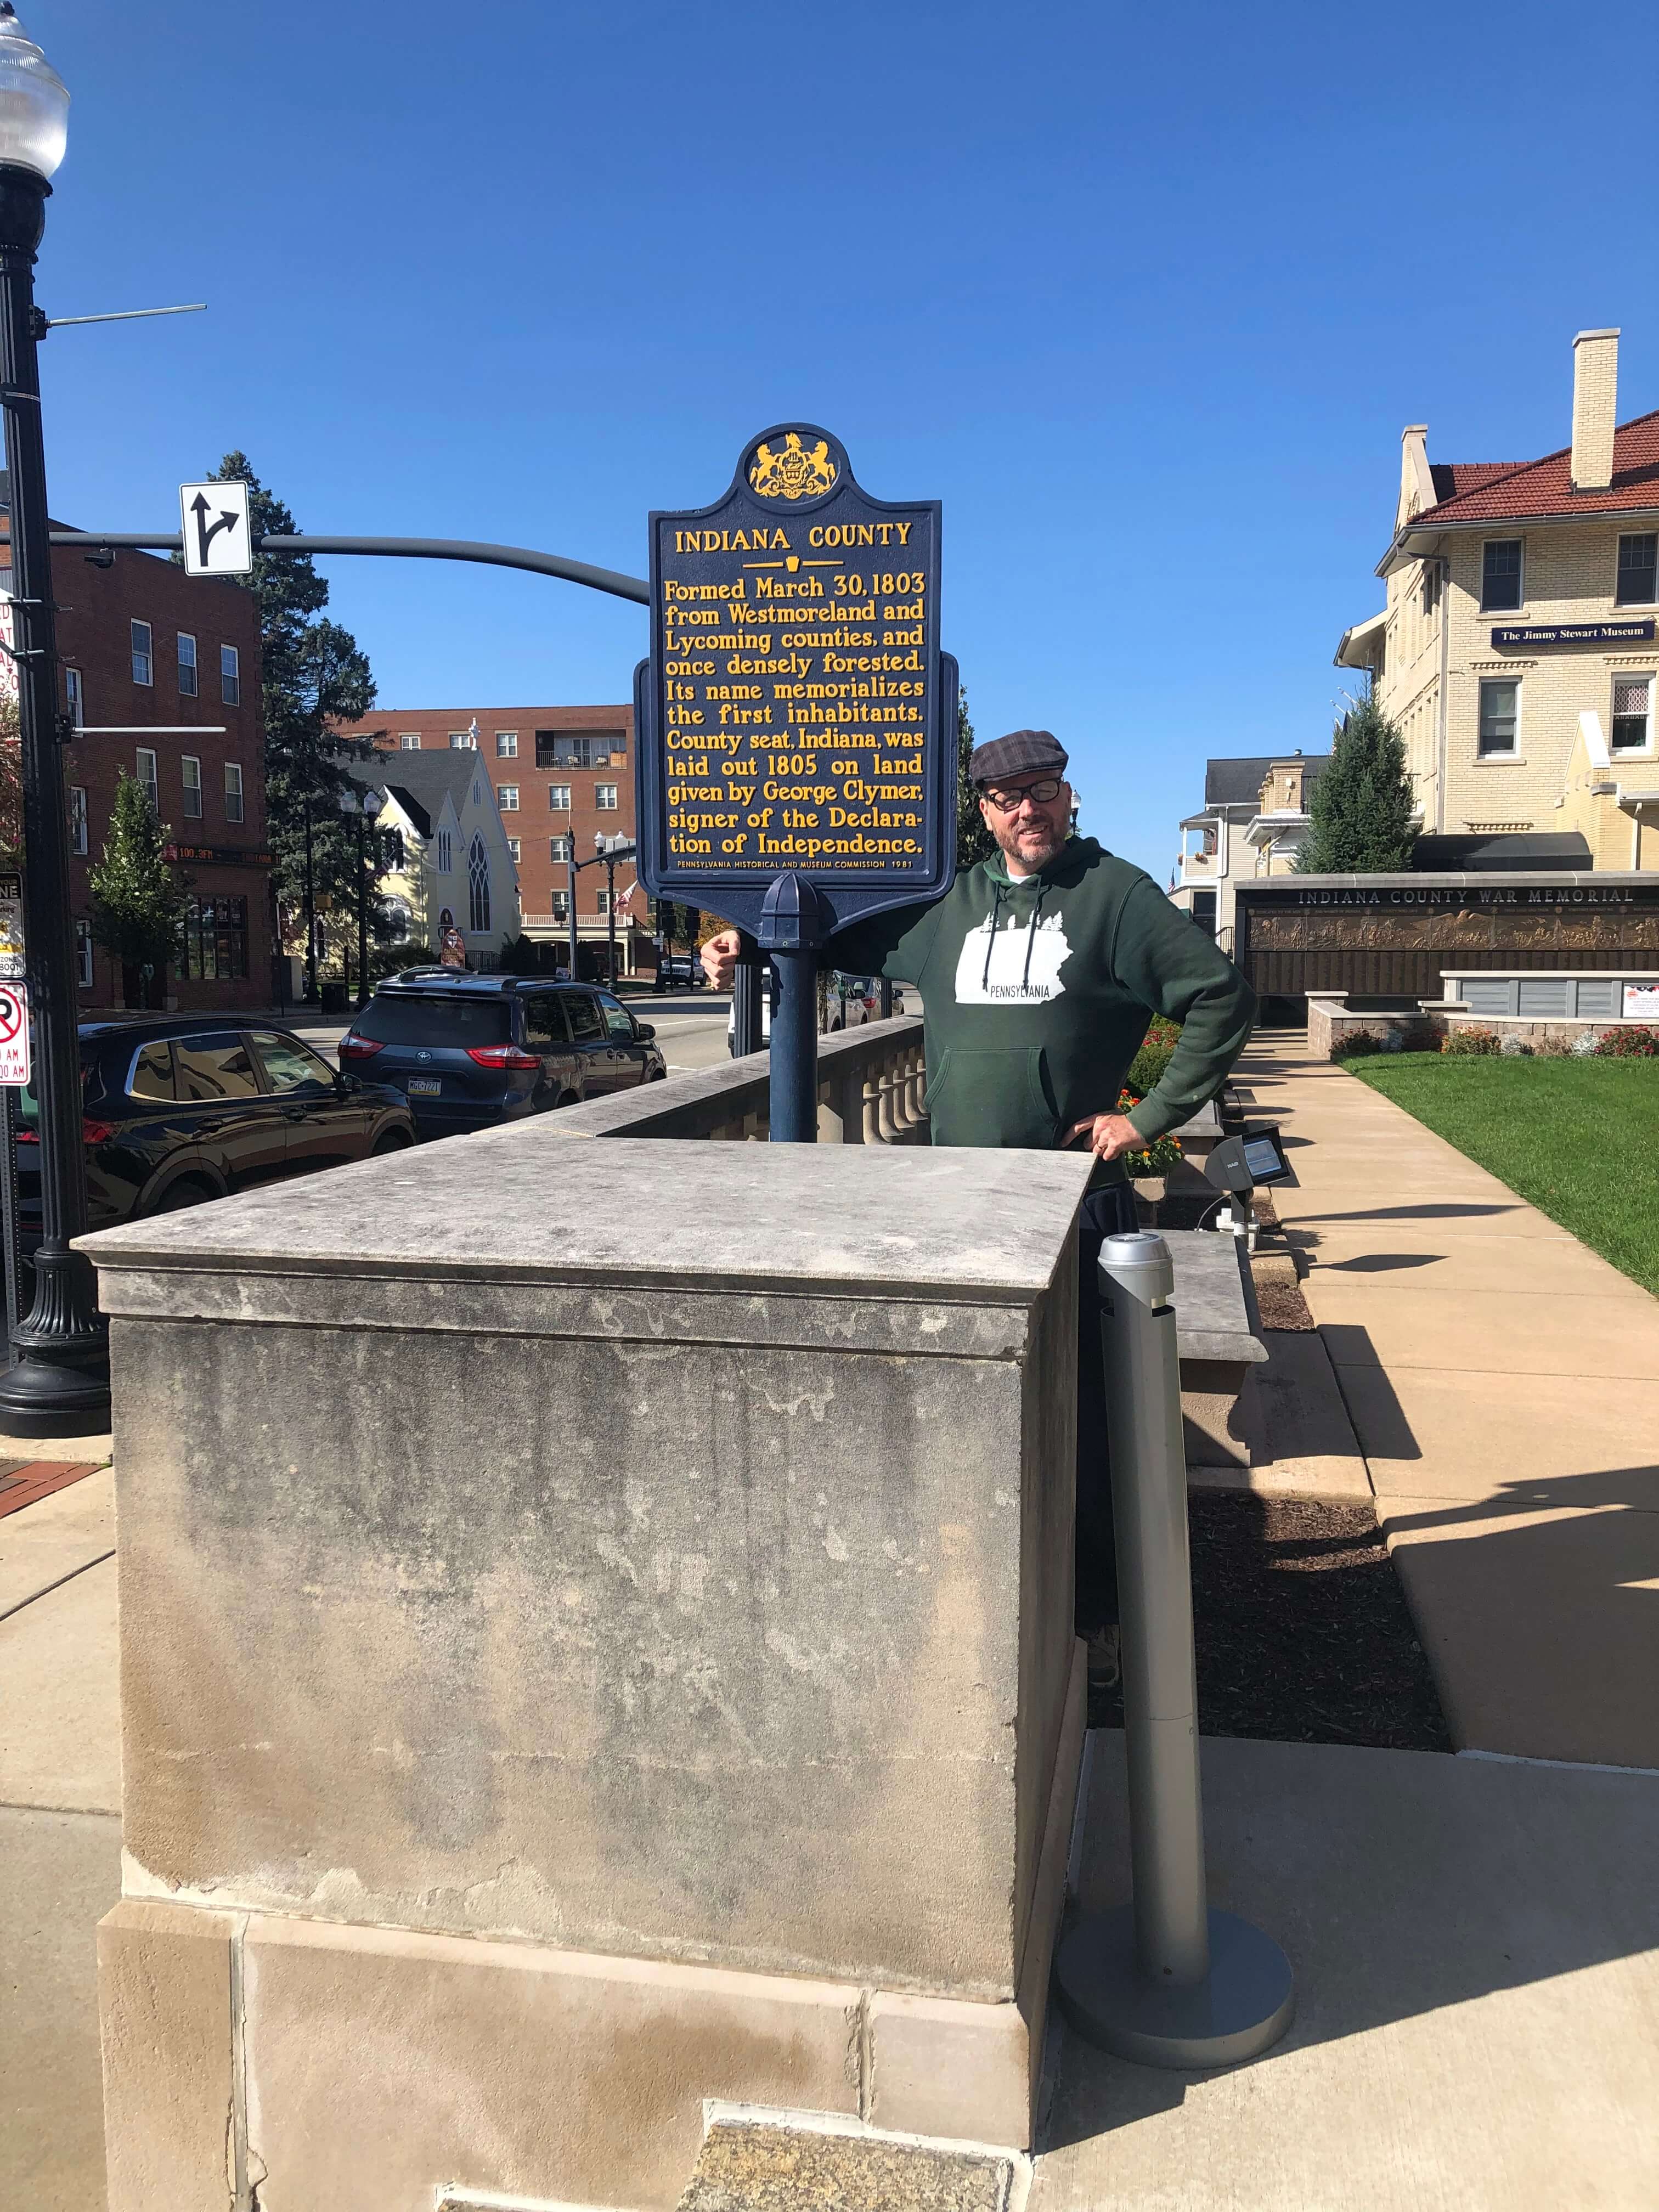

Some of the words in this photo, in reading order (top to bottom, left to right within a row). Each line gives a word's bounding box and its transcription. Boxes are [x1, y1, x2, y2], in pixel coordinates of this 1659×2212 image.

[676, 529, 789, 552] INDIANA
[809, 523, 910, 547] COUNTY
[665, 579, 746, 600] Formed
[757, 576, 823, 598] March
[834, 574, 867, 595] 30,
[873, 573, 924, 594] 1803
[665, 606, 719, 625] from
[729, 600, 876, 623] Westmoreland
[884, 599, 924, 620] and
[667, 630, 771, 657] Lycoming
[781, 630, 877, 647] counties,
[884, 625, 923, 645] and
[1502, 631, 1520, 641] The
[1522, 630, 1558, 641] Jimmy
[1560, 628, 1598, 639] Stewart
[1601, 627, 1644, 637] Museum
[667, 661, 714, 675] once
[727, 652, 811, 679] densely
[824, 650, 924, 672] forested.
[668, 680, 694, 700] Its
[707, 686, 761, 699] name
[774, 676, 923, 698] memorializes
[669, 704, 702, 724] the
[720, 704, 771, 724] first
[788, 702, 922, 723] inhabitants.
[667, 730, 742, 754] County
[751, 731, 795, 750] seat,
[799, 729, 880, 748] Indiana,
[884, 733, 923, 747] was
[668, 756, 709, 776] laid
[721, 759, 757, 775] out
[769, 754, 816, 775] 1805
[832, 761, 859, 775] on
[874, 753, 922, 774] land
[668, 781, 723, 805] given
[729, 781, 755, 806] by
[764, 781, 836, 805] George
[844, 780, 922, 805] Clymer,
[669, 809, 738, 833] signer
[747, 808, 773, 827] of
[783, 808, 819, 827] the
[830, 807, 923, 827] Declara-
[670, 834, 710, 853] tion
[722, 834, 747, 853] of
[759, 833, 922, 857] Independence.
[678, 860, 731, 868] PENNSYLVANIA
[735, 860, 779, 868] HISTORICAL
[782, 860, 798, 868] AND
[800, 860, 832, 868] MUSEUM
[835, 860, 884, 868] COMMISSION
[891, 860, 912, 868] 1981
[1299, 891, 1380, 904] INDIANA
[1391, 890, 1468, 903] COUNTY
[1479, 890, 1517, 903] WAR
[1528, 889, 1633, 902] MEMORIAL
[991, 985, 1049, 997] PENNSYLVANIA
[7, 1048, 18, 1061] AM
[13, 1065, 24, 1077] AM
